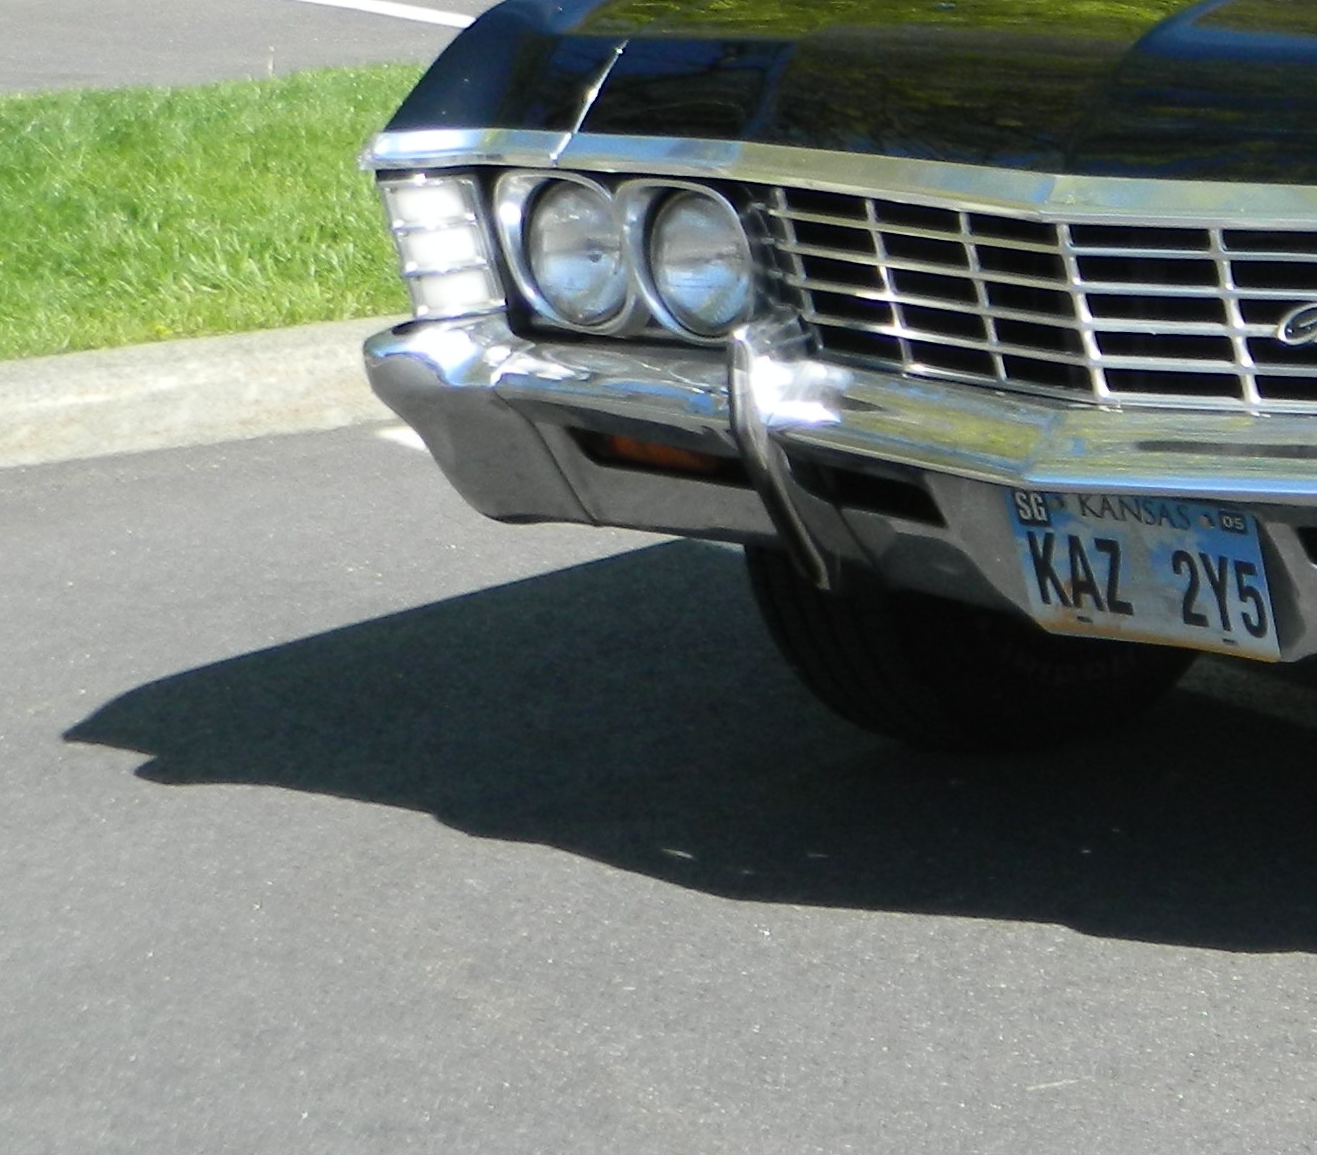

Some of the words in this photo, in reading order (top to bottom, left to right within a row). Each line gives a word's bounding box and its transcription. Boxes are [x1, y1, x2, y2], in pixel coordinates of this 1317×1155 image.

[1015, 491, 1048, 522] SG
[1078, 493, 1191, 531] KANSAS
[1026, 530, 1134, 616] KAZ
[1171, 549, 1268, 639] 2Y5
